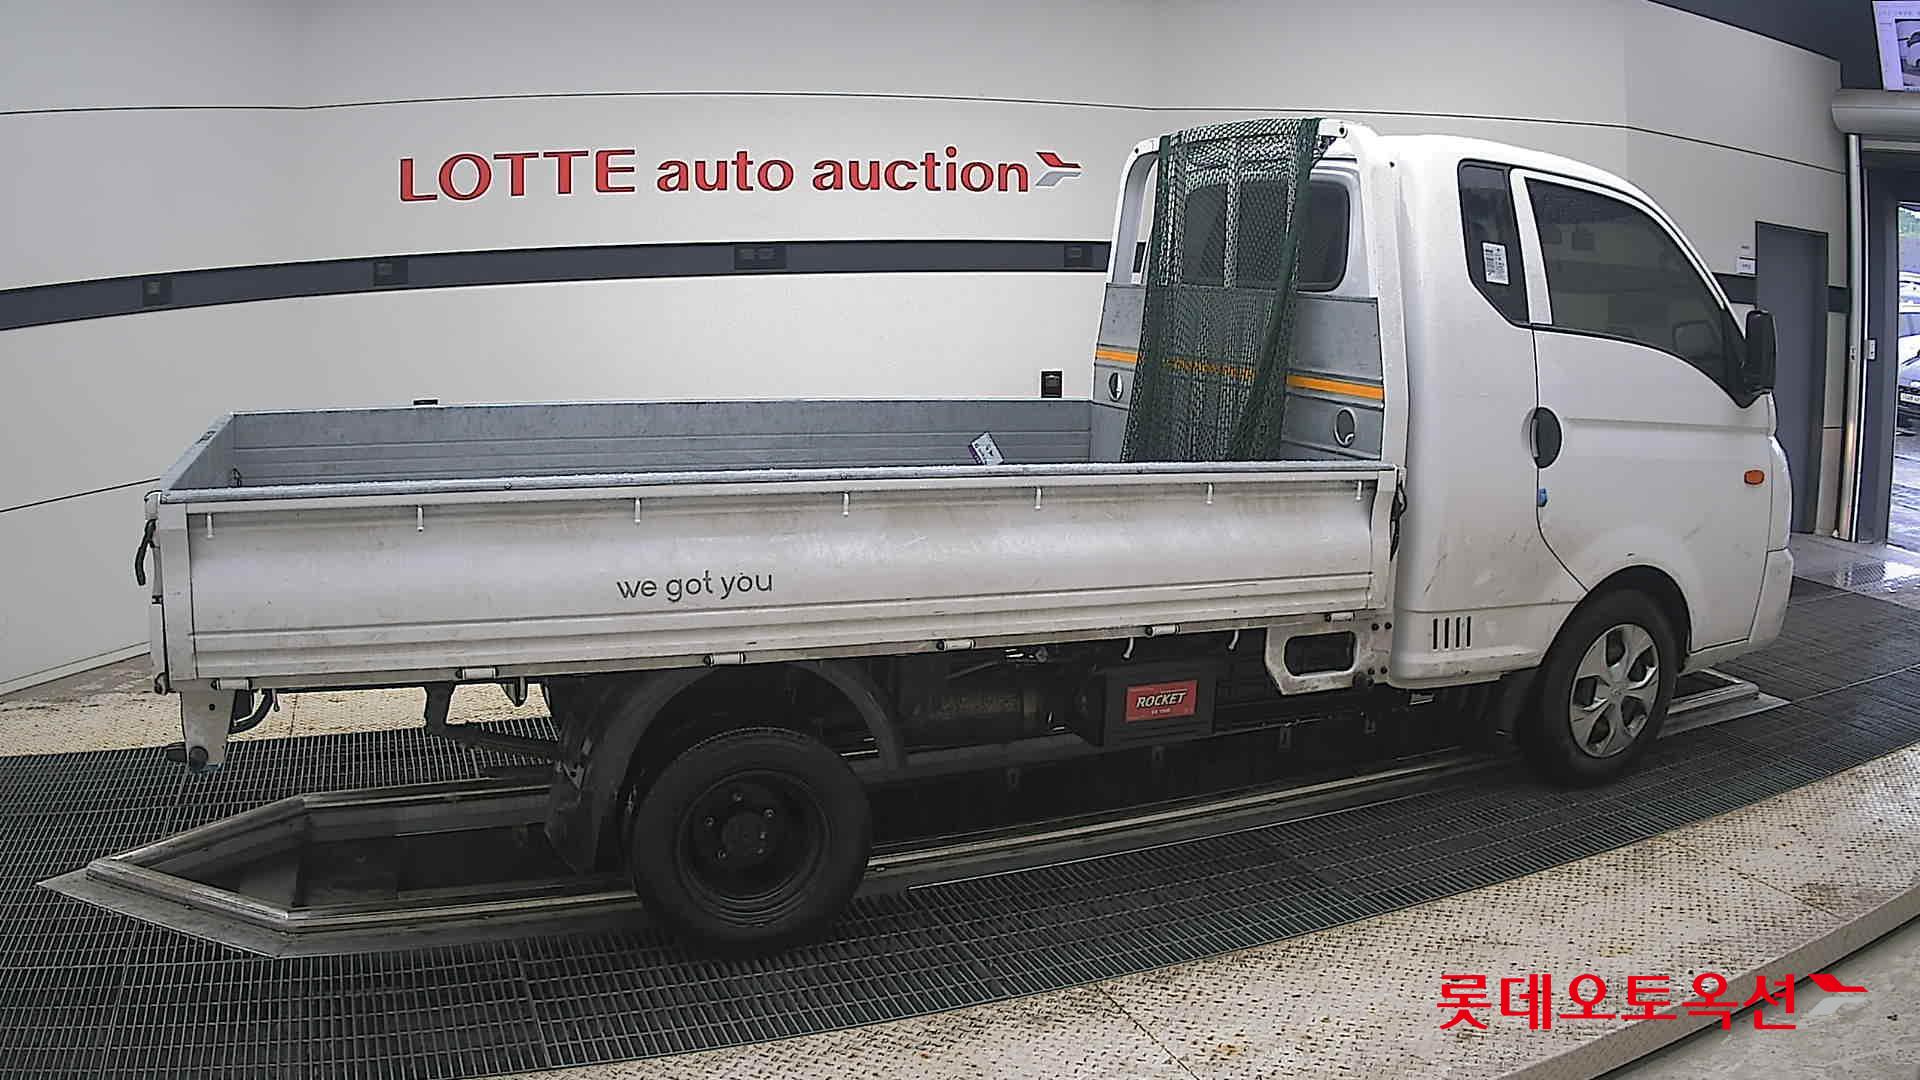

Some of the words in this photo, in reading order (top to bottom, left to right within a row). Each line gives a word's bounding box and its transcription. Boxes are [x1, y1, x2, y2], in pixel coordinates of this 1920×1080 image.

[400, 149, 636, 201] LOTTE
[657, 151, 794, 192] auto
[813, 147, 1030, 192] auction
[616, 580, 657, 599] we
[665, 569, 713, 603] got
[720, 573, 773, 600] you
[1136, 692, 1187, 708] ROCKET
